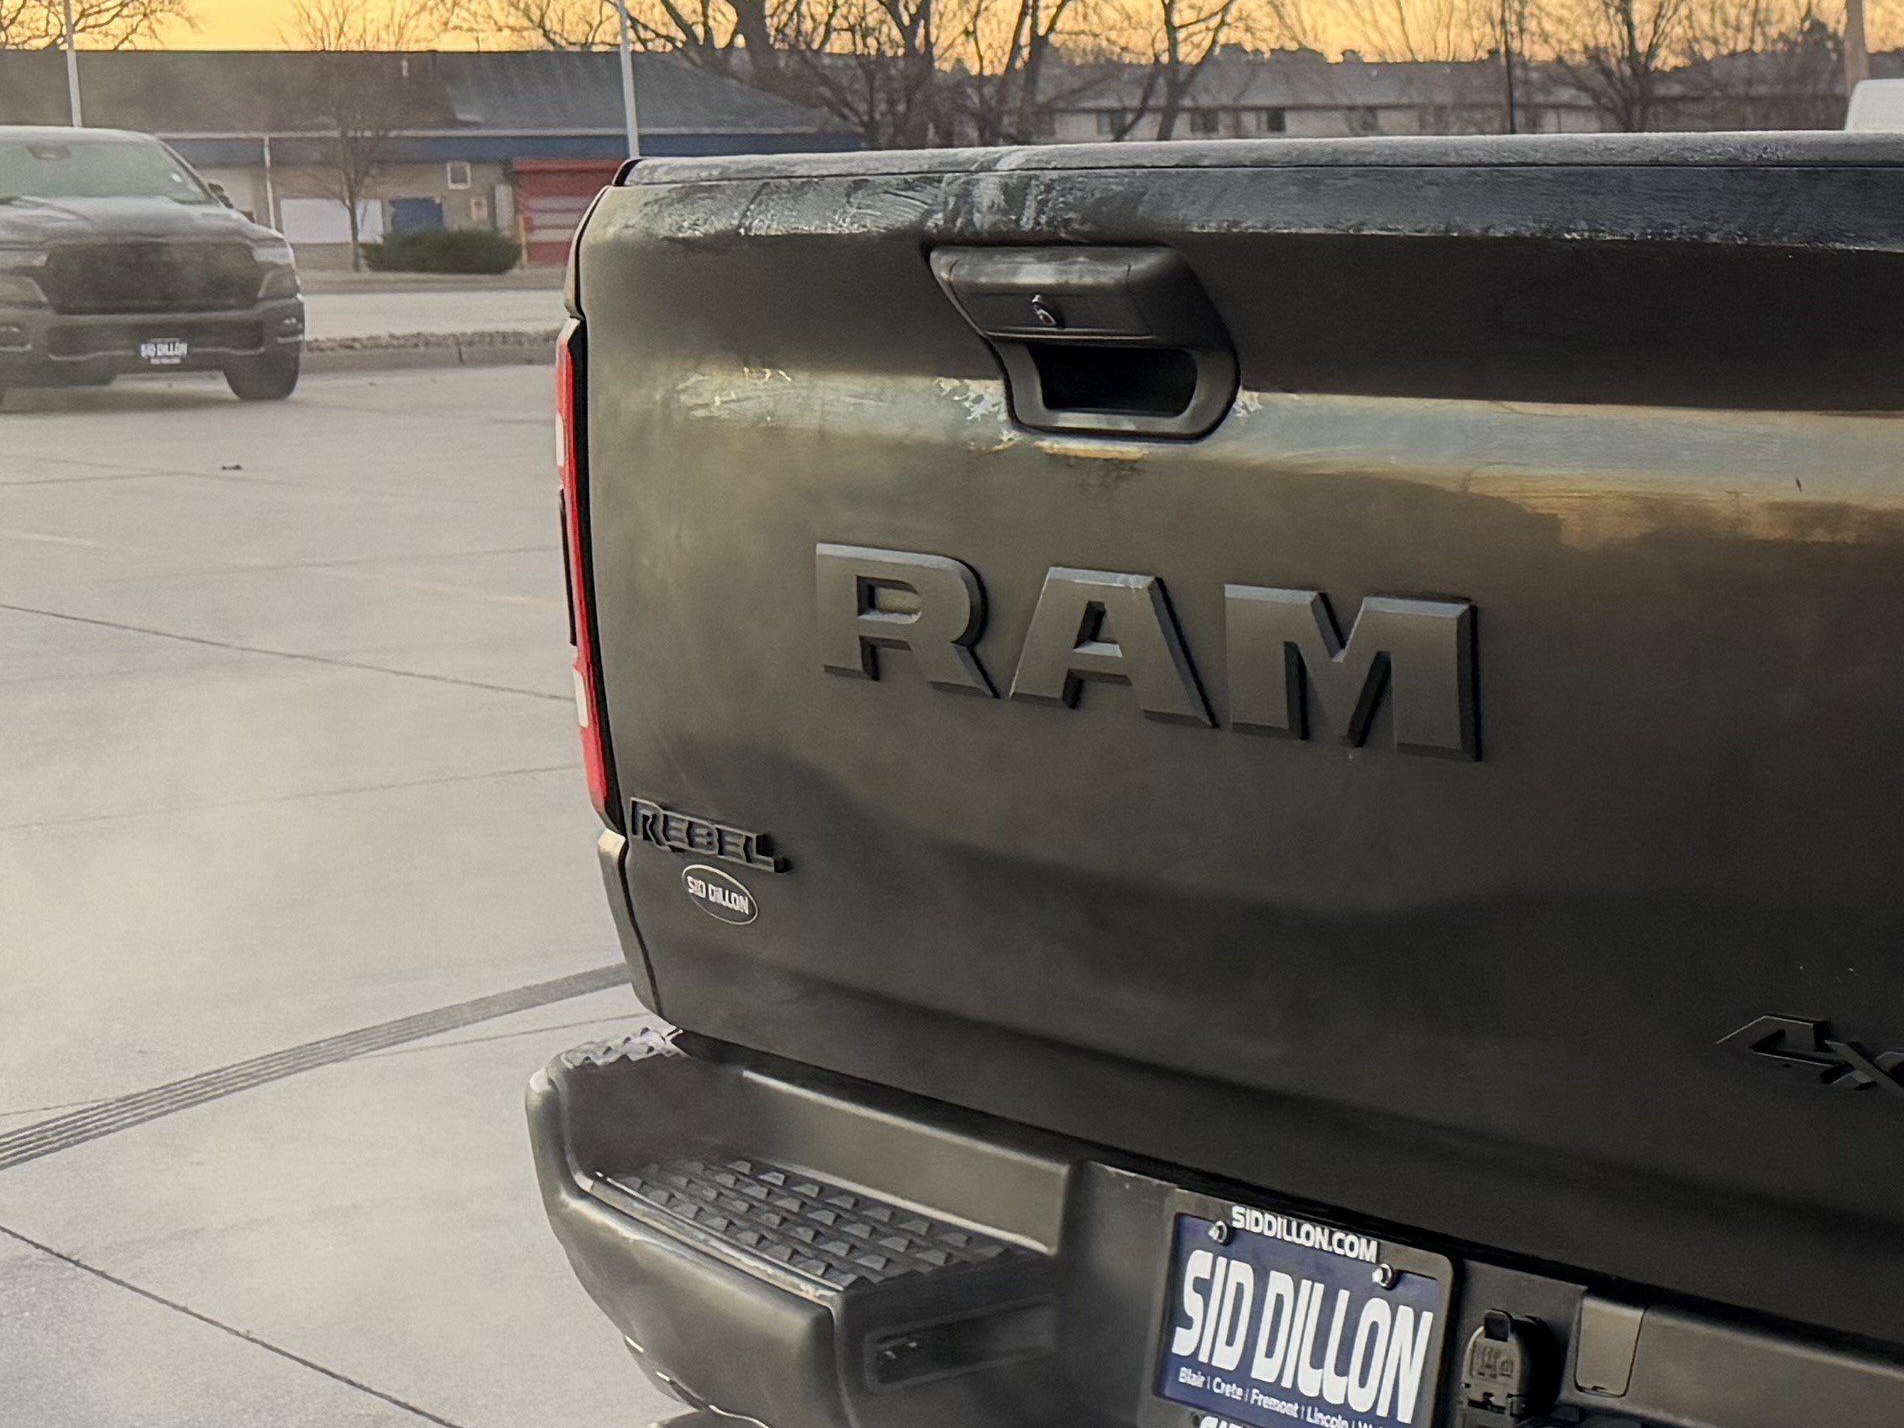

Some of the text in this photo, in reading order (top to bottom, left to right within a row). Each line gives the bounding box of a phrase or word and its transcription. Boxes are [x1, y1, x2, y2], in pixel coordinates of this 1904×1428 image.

[815, 541, 1482, 762] RAM
[630, 796, 782, 873] REBEL
[686, 875, 749, 915] SID DILLON
[1231, 1205, 1379, 1263] SIDDILLON.COM
[1171, 1249, 1434, 1424] SID DILLON
[1178, 1366, 1205, 1388] Blair
[1212, 1377, 1244, 1402] Crete
[1250, 1388, 1300, 1419] Fremont
